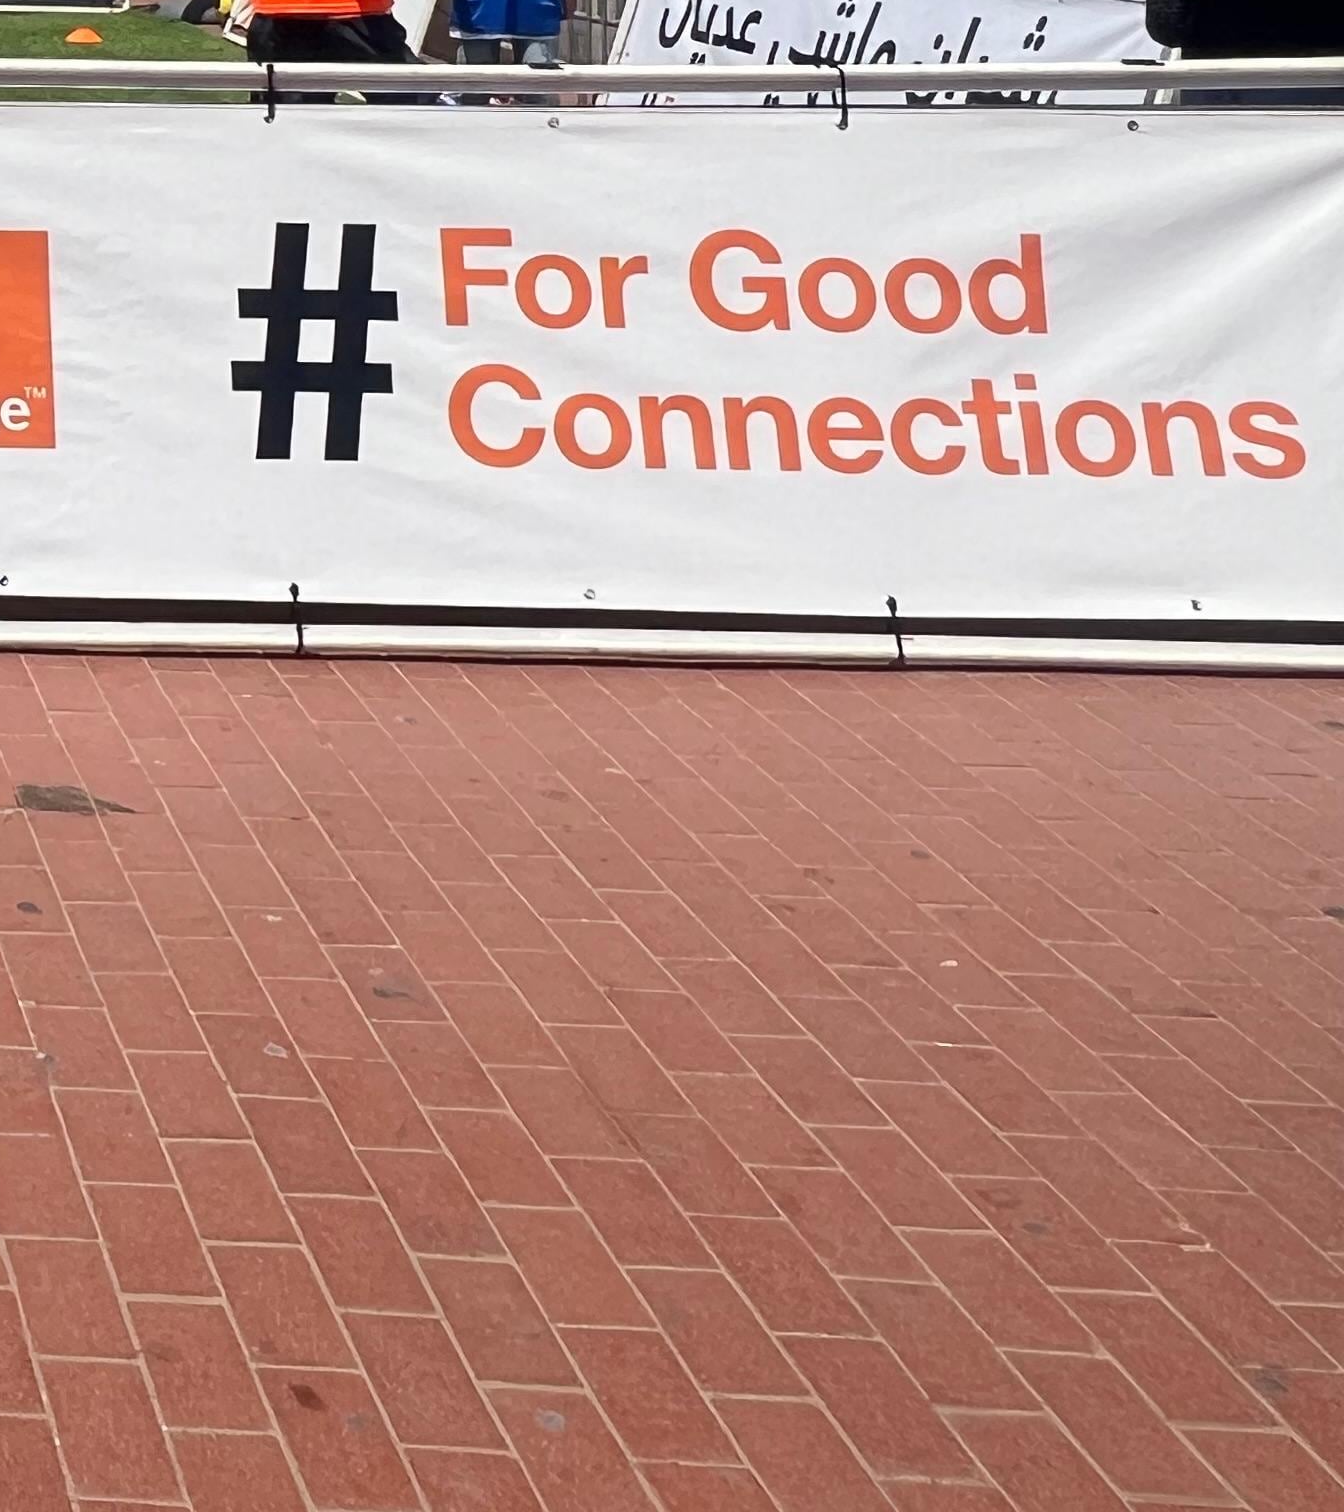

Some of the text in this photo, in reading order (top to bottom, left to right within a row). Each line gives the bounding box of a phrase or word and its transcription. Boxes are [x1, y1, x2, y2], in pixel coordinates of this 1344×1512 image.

[230, 222, 1050, 462] # For Good
[447, 363, 1307, 480] Connections
